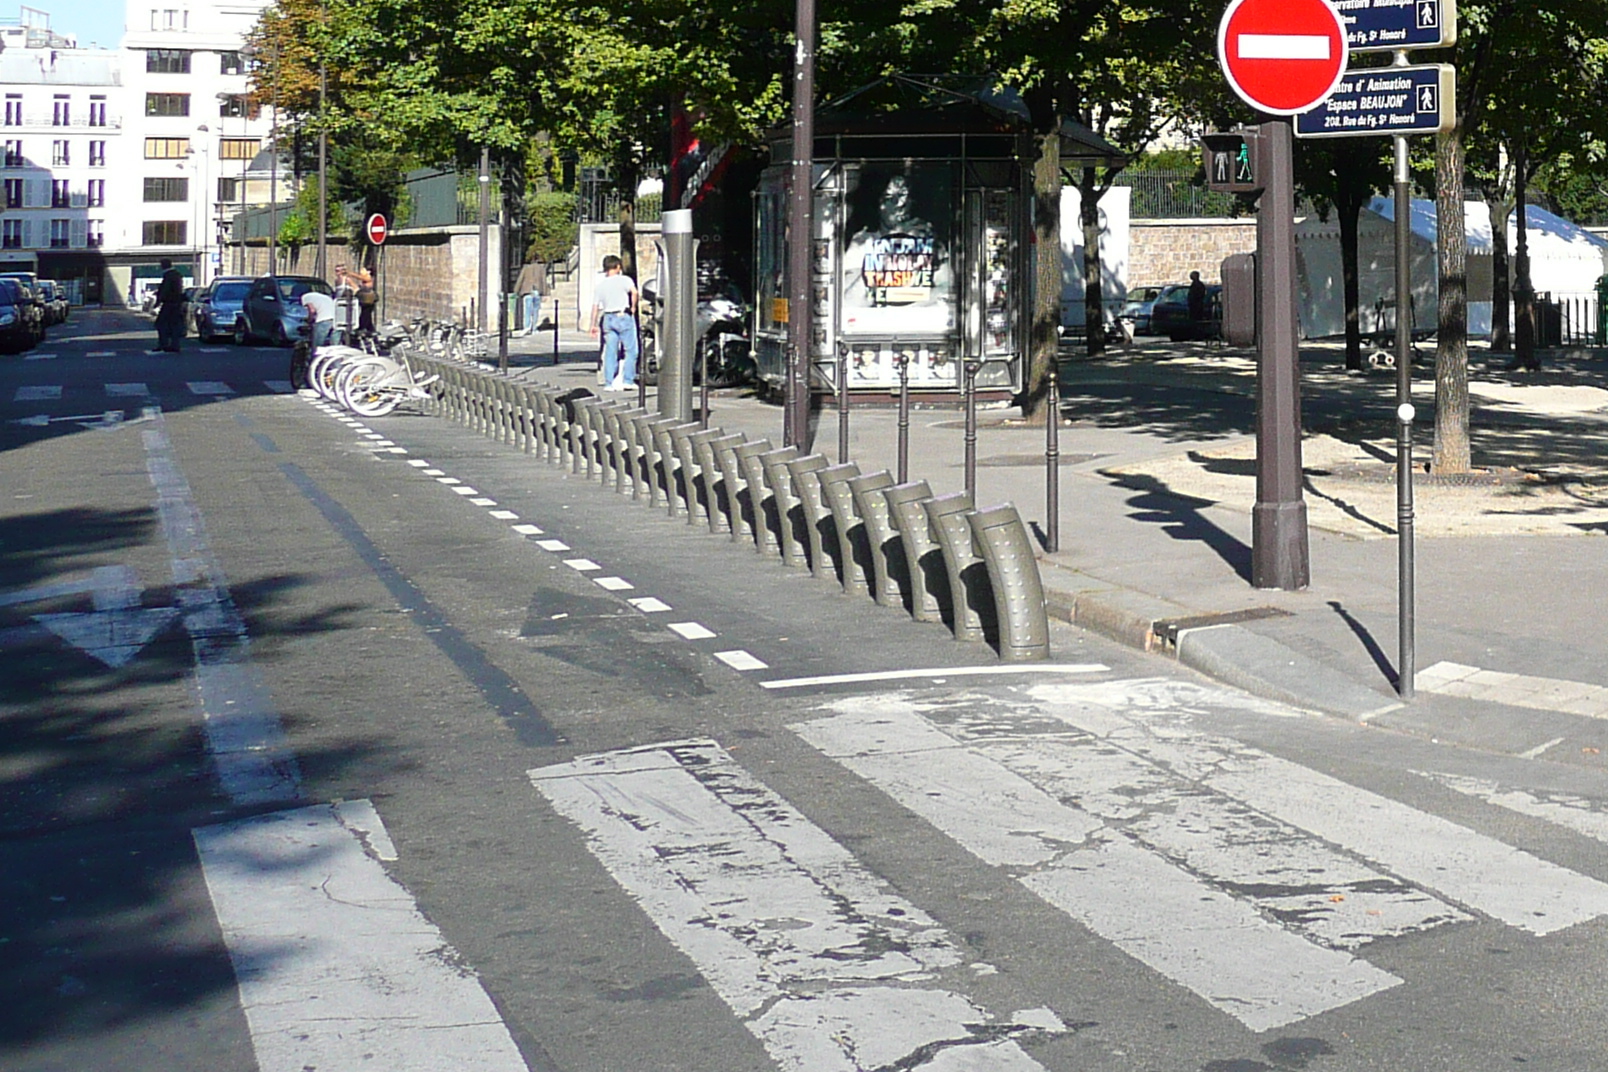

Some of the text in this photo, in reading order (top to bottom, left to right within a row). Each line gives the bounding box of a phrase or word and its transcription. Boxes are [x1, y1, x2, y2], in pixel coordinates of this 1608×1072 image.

[1380, 28, 1406, 41] Honoré
[1334, 80, 1353, 93] ntre
[1367, 77, 1412, 92] Animation
[1343, 115, 1356, 127] Rue
[1357, 115, 1366, 125] du
[1389, 112, 1415, 125] Honoré
